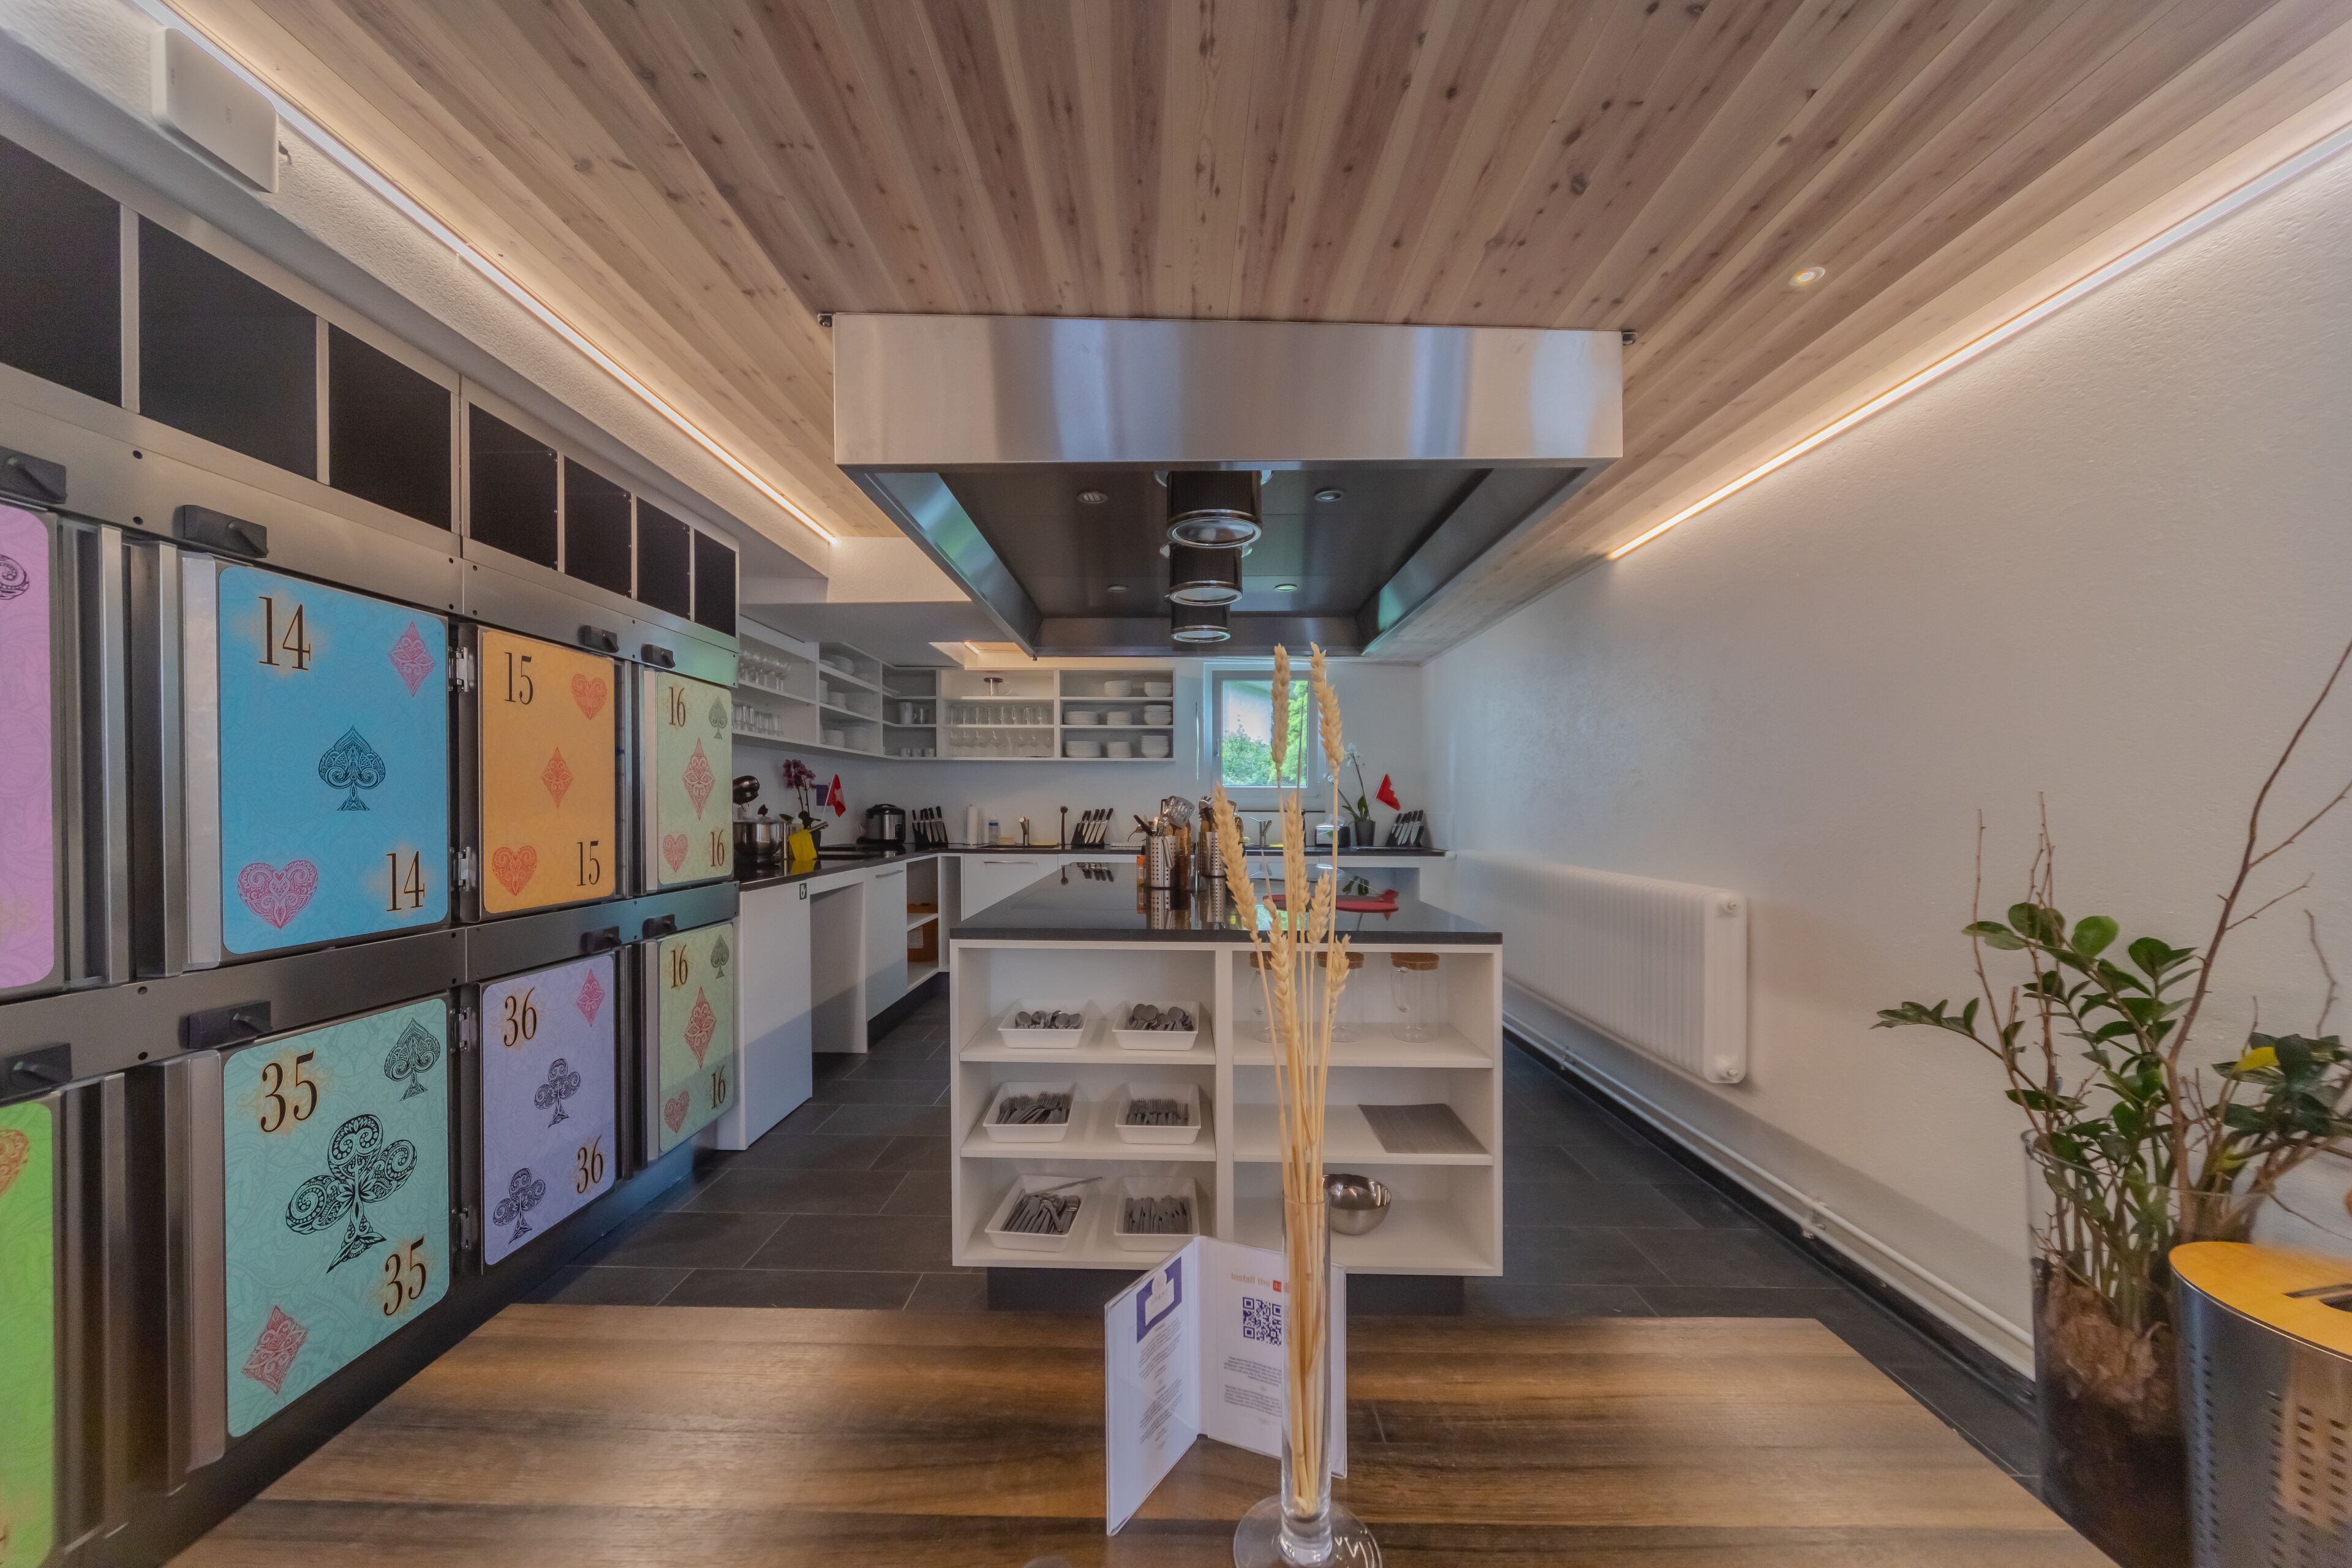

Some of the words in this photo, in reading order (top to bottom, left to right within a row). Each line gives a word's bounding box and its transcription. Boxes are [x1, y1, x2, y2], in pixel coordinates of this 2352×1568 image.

[258, 596, 311, 671] 14
[504, 652, 533, 705] 15
[669, 687, 686, 727] 16
[576, 840, 600, 886] 15
[710, 829, 725, 867] 16
[386, 850, 425, 912] 14
[670, 944, 688, 989] 16
[503, 987, 537, 1047] 36
[260, 1050, 318, 1133] 35
[710, 1066, 726, 1109] 16
[576, 1136, 603, 1194] 36
[383, 1235, 428, 1317] 35
[1231, 1272, 1254, 1284] Install
[1257, 1277, 1270, 1287] the
